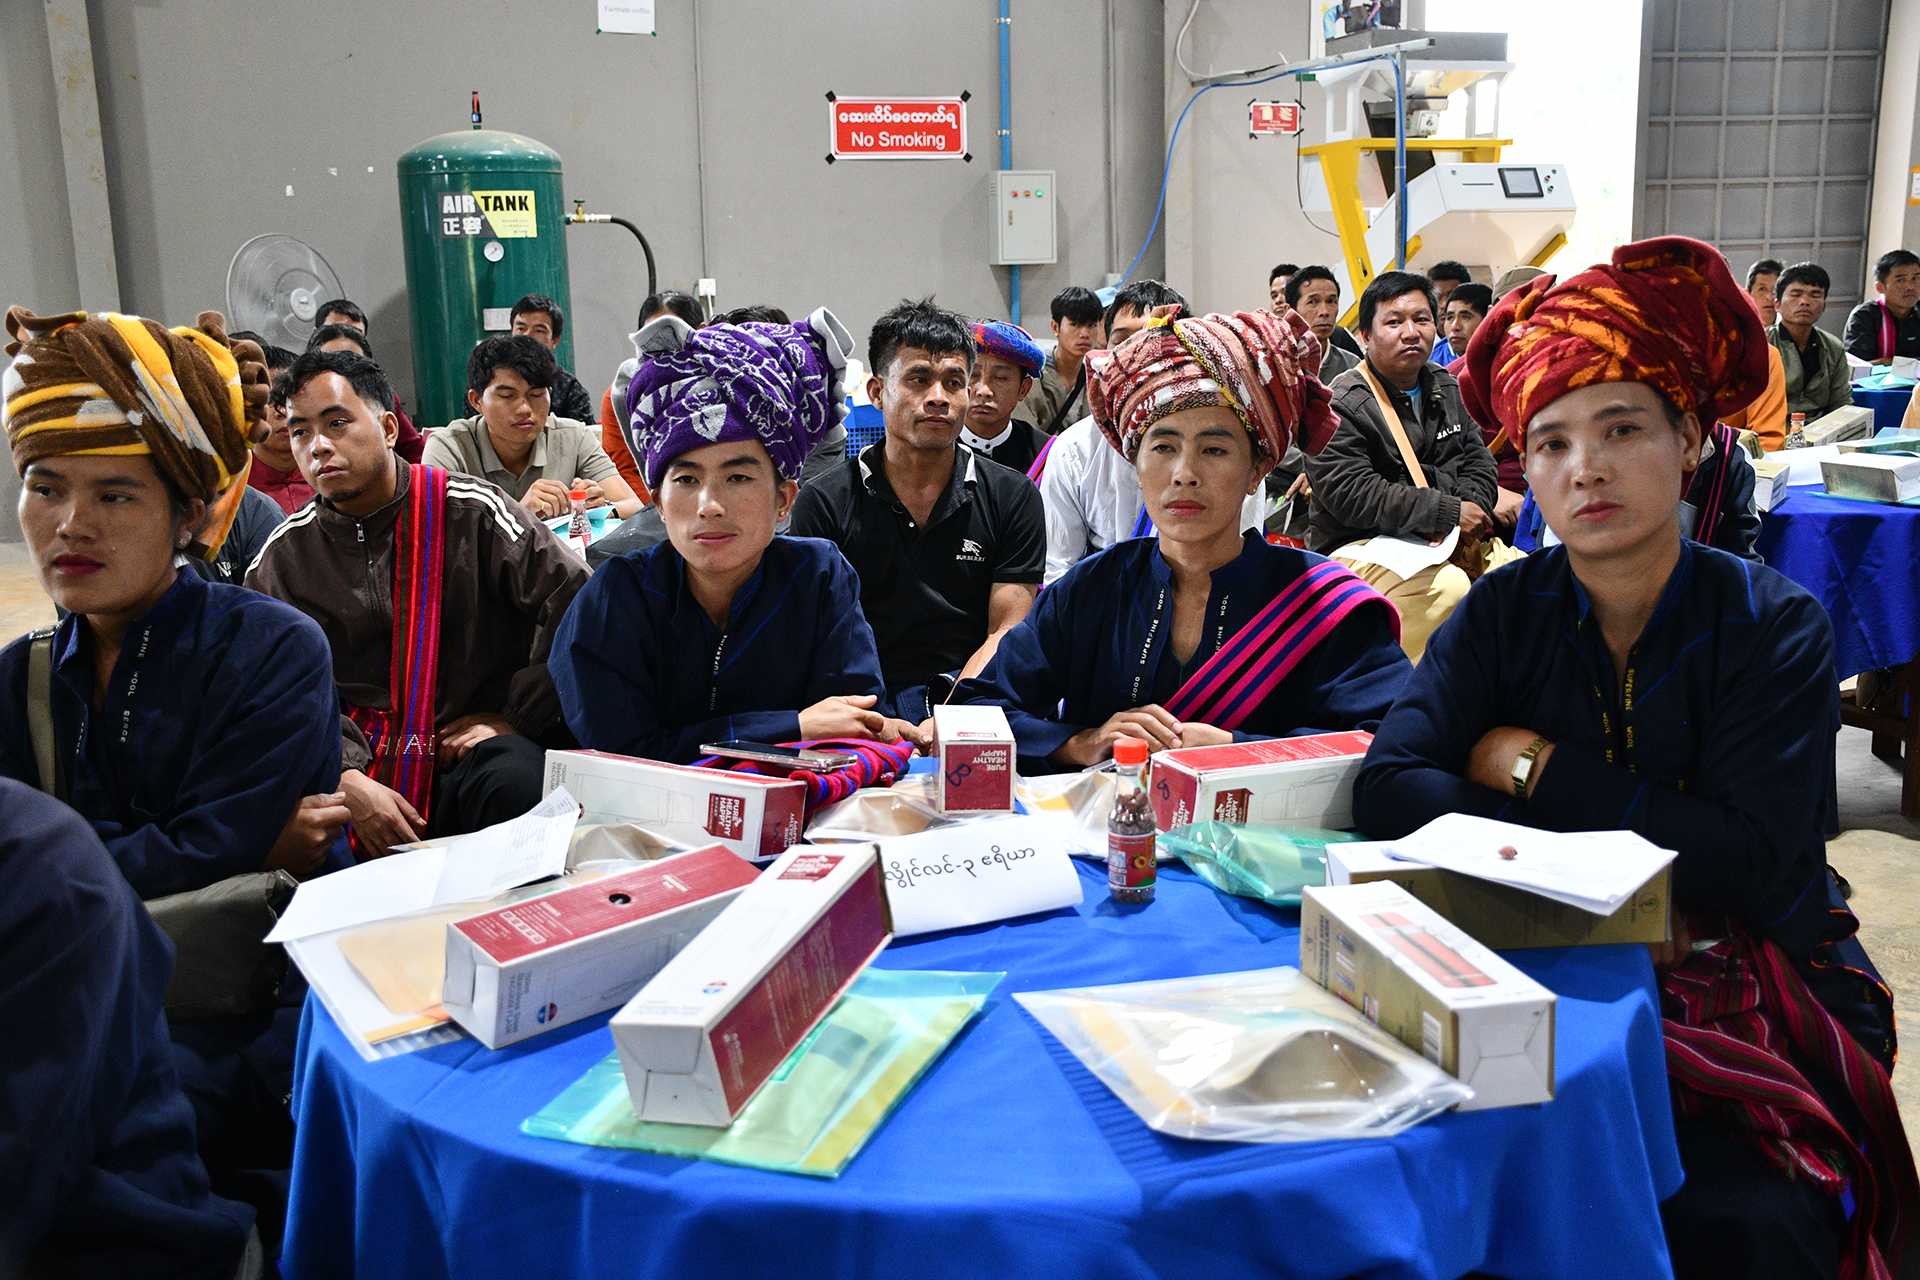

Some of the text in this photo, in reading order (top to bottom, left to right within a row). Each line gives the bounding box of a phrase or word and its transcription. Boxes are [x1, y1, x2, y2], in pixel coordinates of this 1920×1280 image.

[851, 131, 946, 150] No Smoking
[442, 194, 530, 214] AIR TANK
[442, 215, 482, 236] 正容
[1219, 594, 1229, 616] WOOL
[1139, 618, 1159, 665] SUPERFINE
[1156, 588, 1165, 611] WOOL
[1624, 668, 1635, 749] SUPERFINE WOOL
[718, 797, 727, 827] HAPPY
[724, 798, 733, 837] HEALTHY
[731, 799, 740, 822] PURE
[1177, 799, 1186, 828] EALTHY
[1224, 792, 1233, 824] EALTHY
[1230, 799, 1239, 824] APPY
